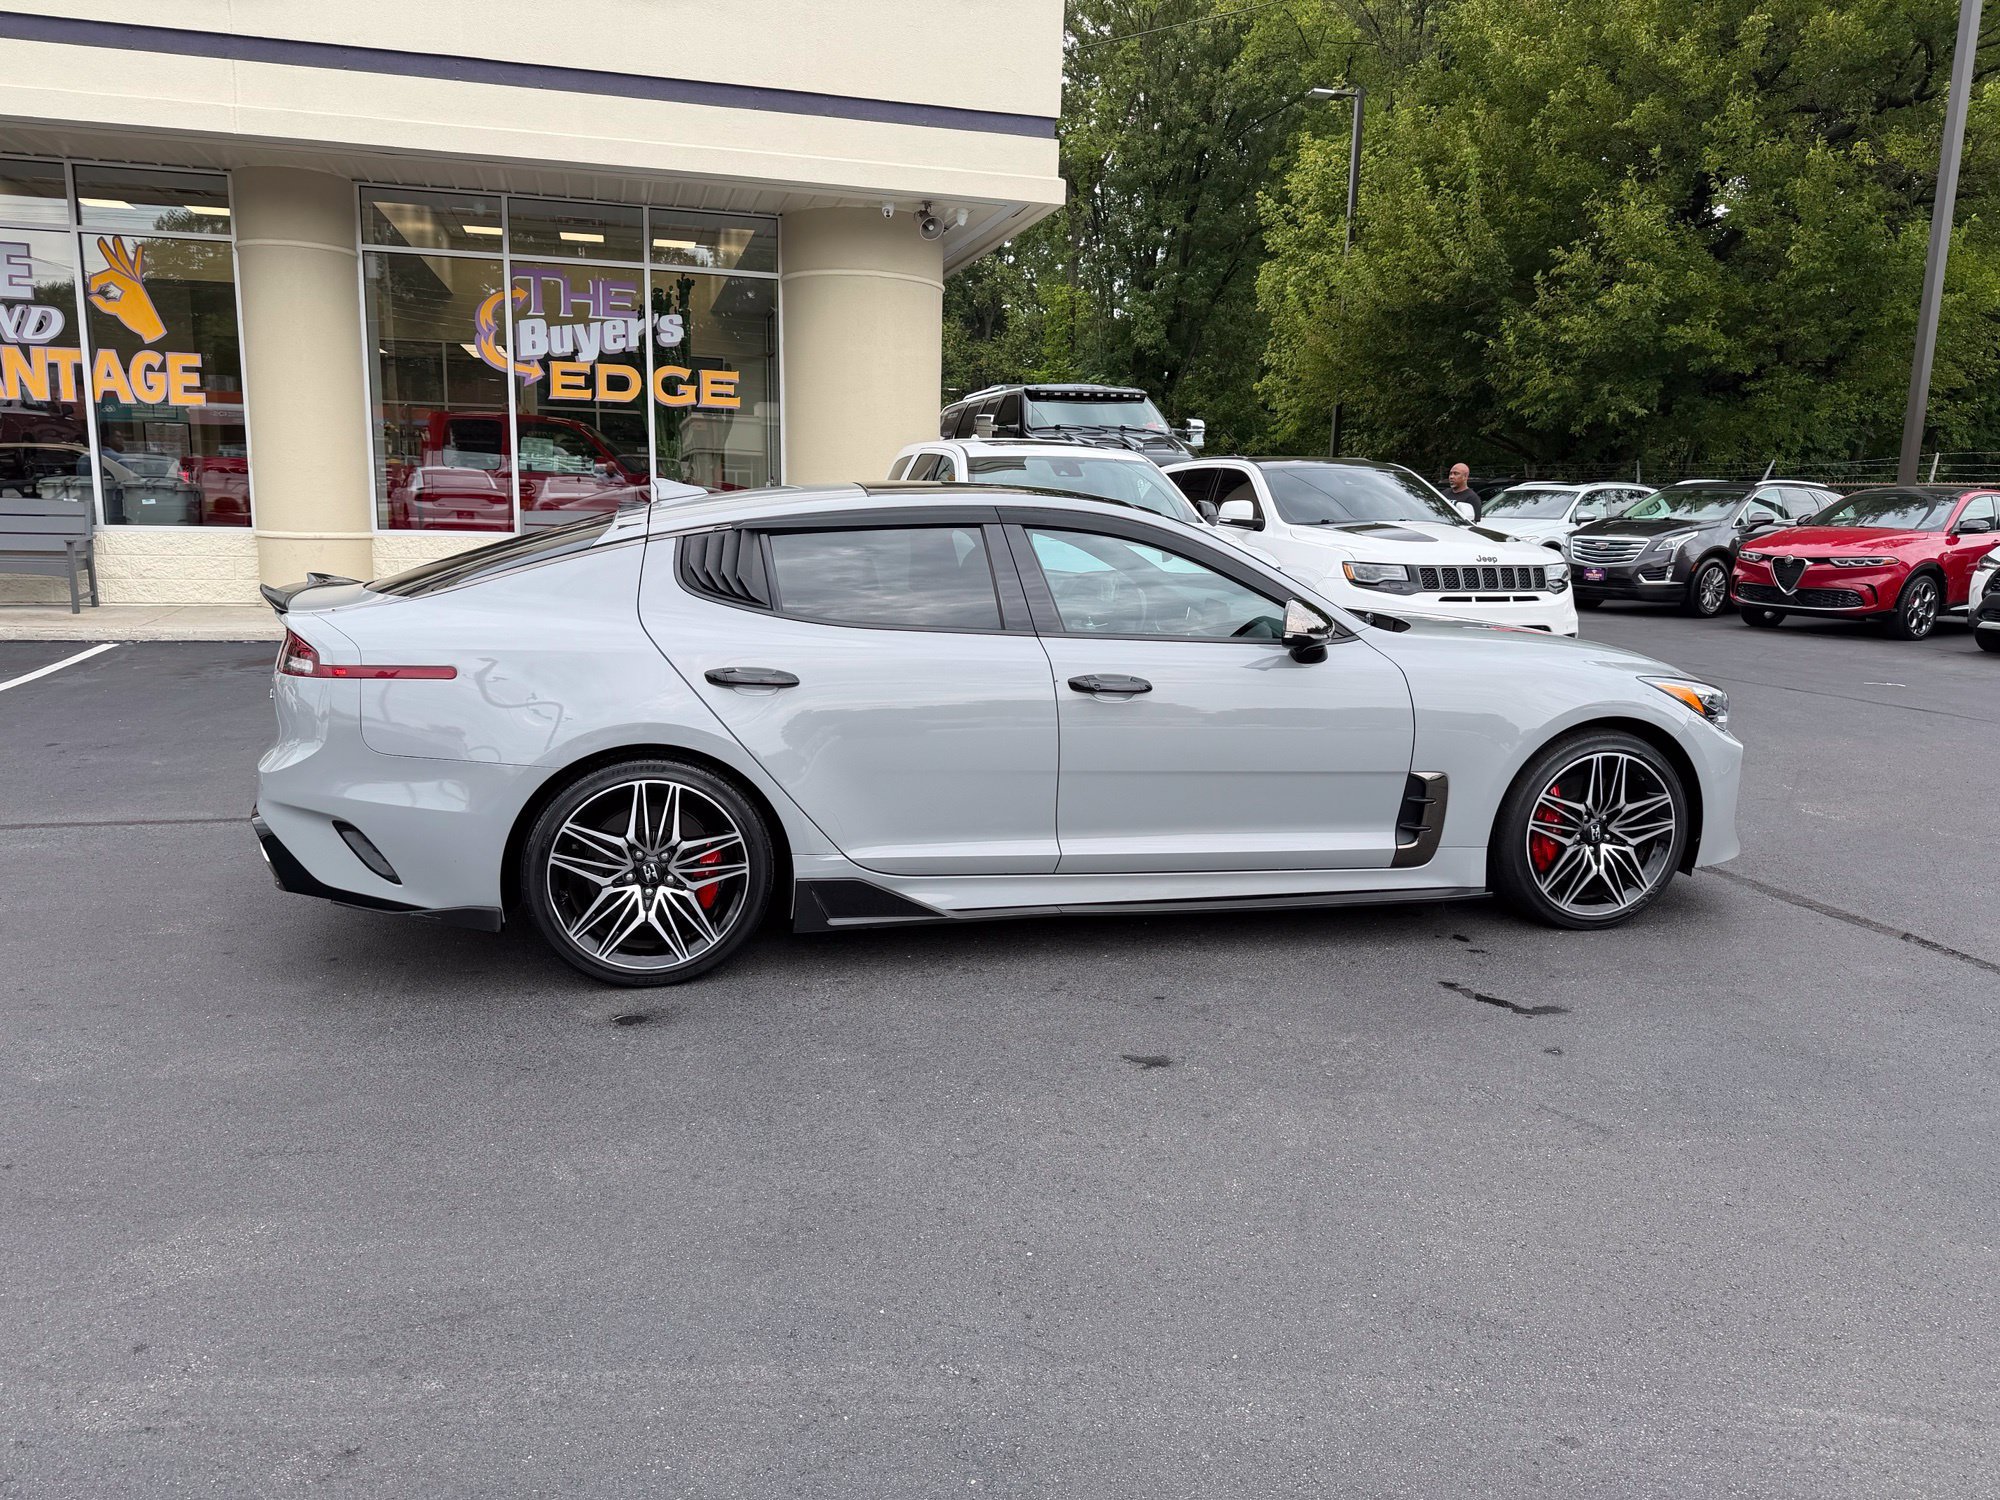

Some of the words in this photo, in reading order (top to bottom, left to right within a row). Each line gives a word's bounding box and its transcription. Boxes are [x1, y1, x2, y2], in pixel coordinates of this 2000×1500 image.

[511, 268, 637, 319] THE
[515, 313, 685, 362] Buyer's
[0, 345, 207, 406] NTAGE
[548, 361, 741, 409] EDGE
[1476, 554, 1498, 564] Jeep
